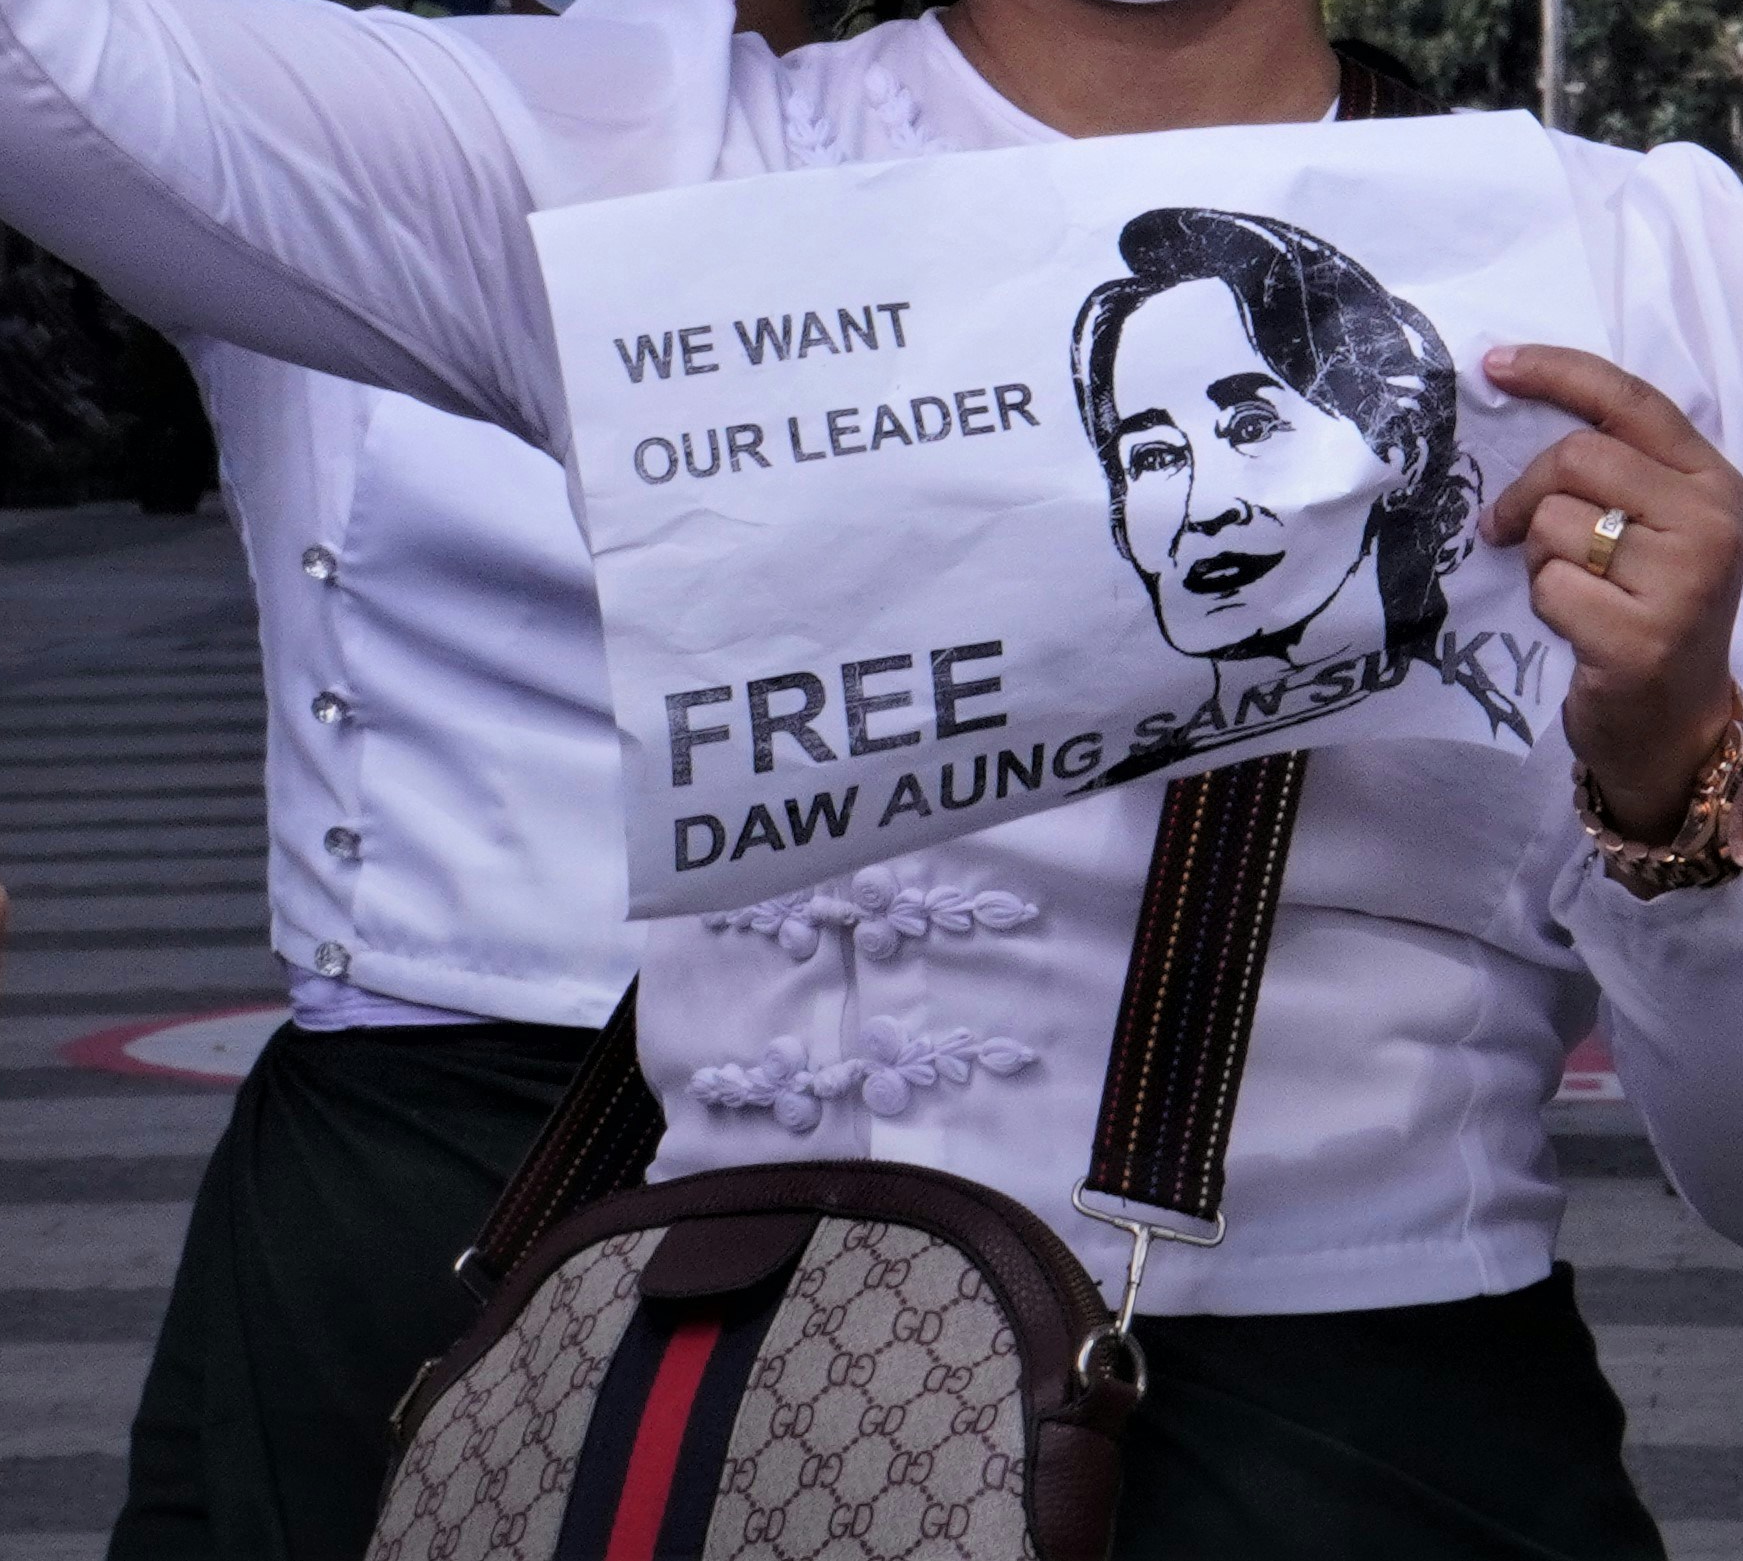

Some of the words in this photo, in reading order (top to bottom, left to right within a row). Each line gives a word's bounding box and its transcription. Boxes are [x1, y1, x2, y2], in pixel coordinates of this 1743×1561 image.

[613, 324, 719, 385] WE
[734, 300, 912, 366] WANT
[633, 423, 772, 485] OUR
[787, 382, 1041, 464] LEADER
[662, 639, 1009, 788] FREE
[672, 783, 859, 872] DAW
[877, 730, 1102, 829] AUNG
